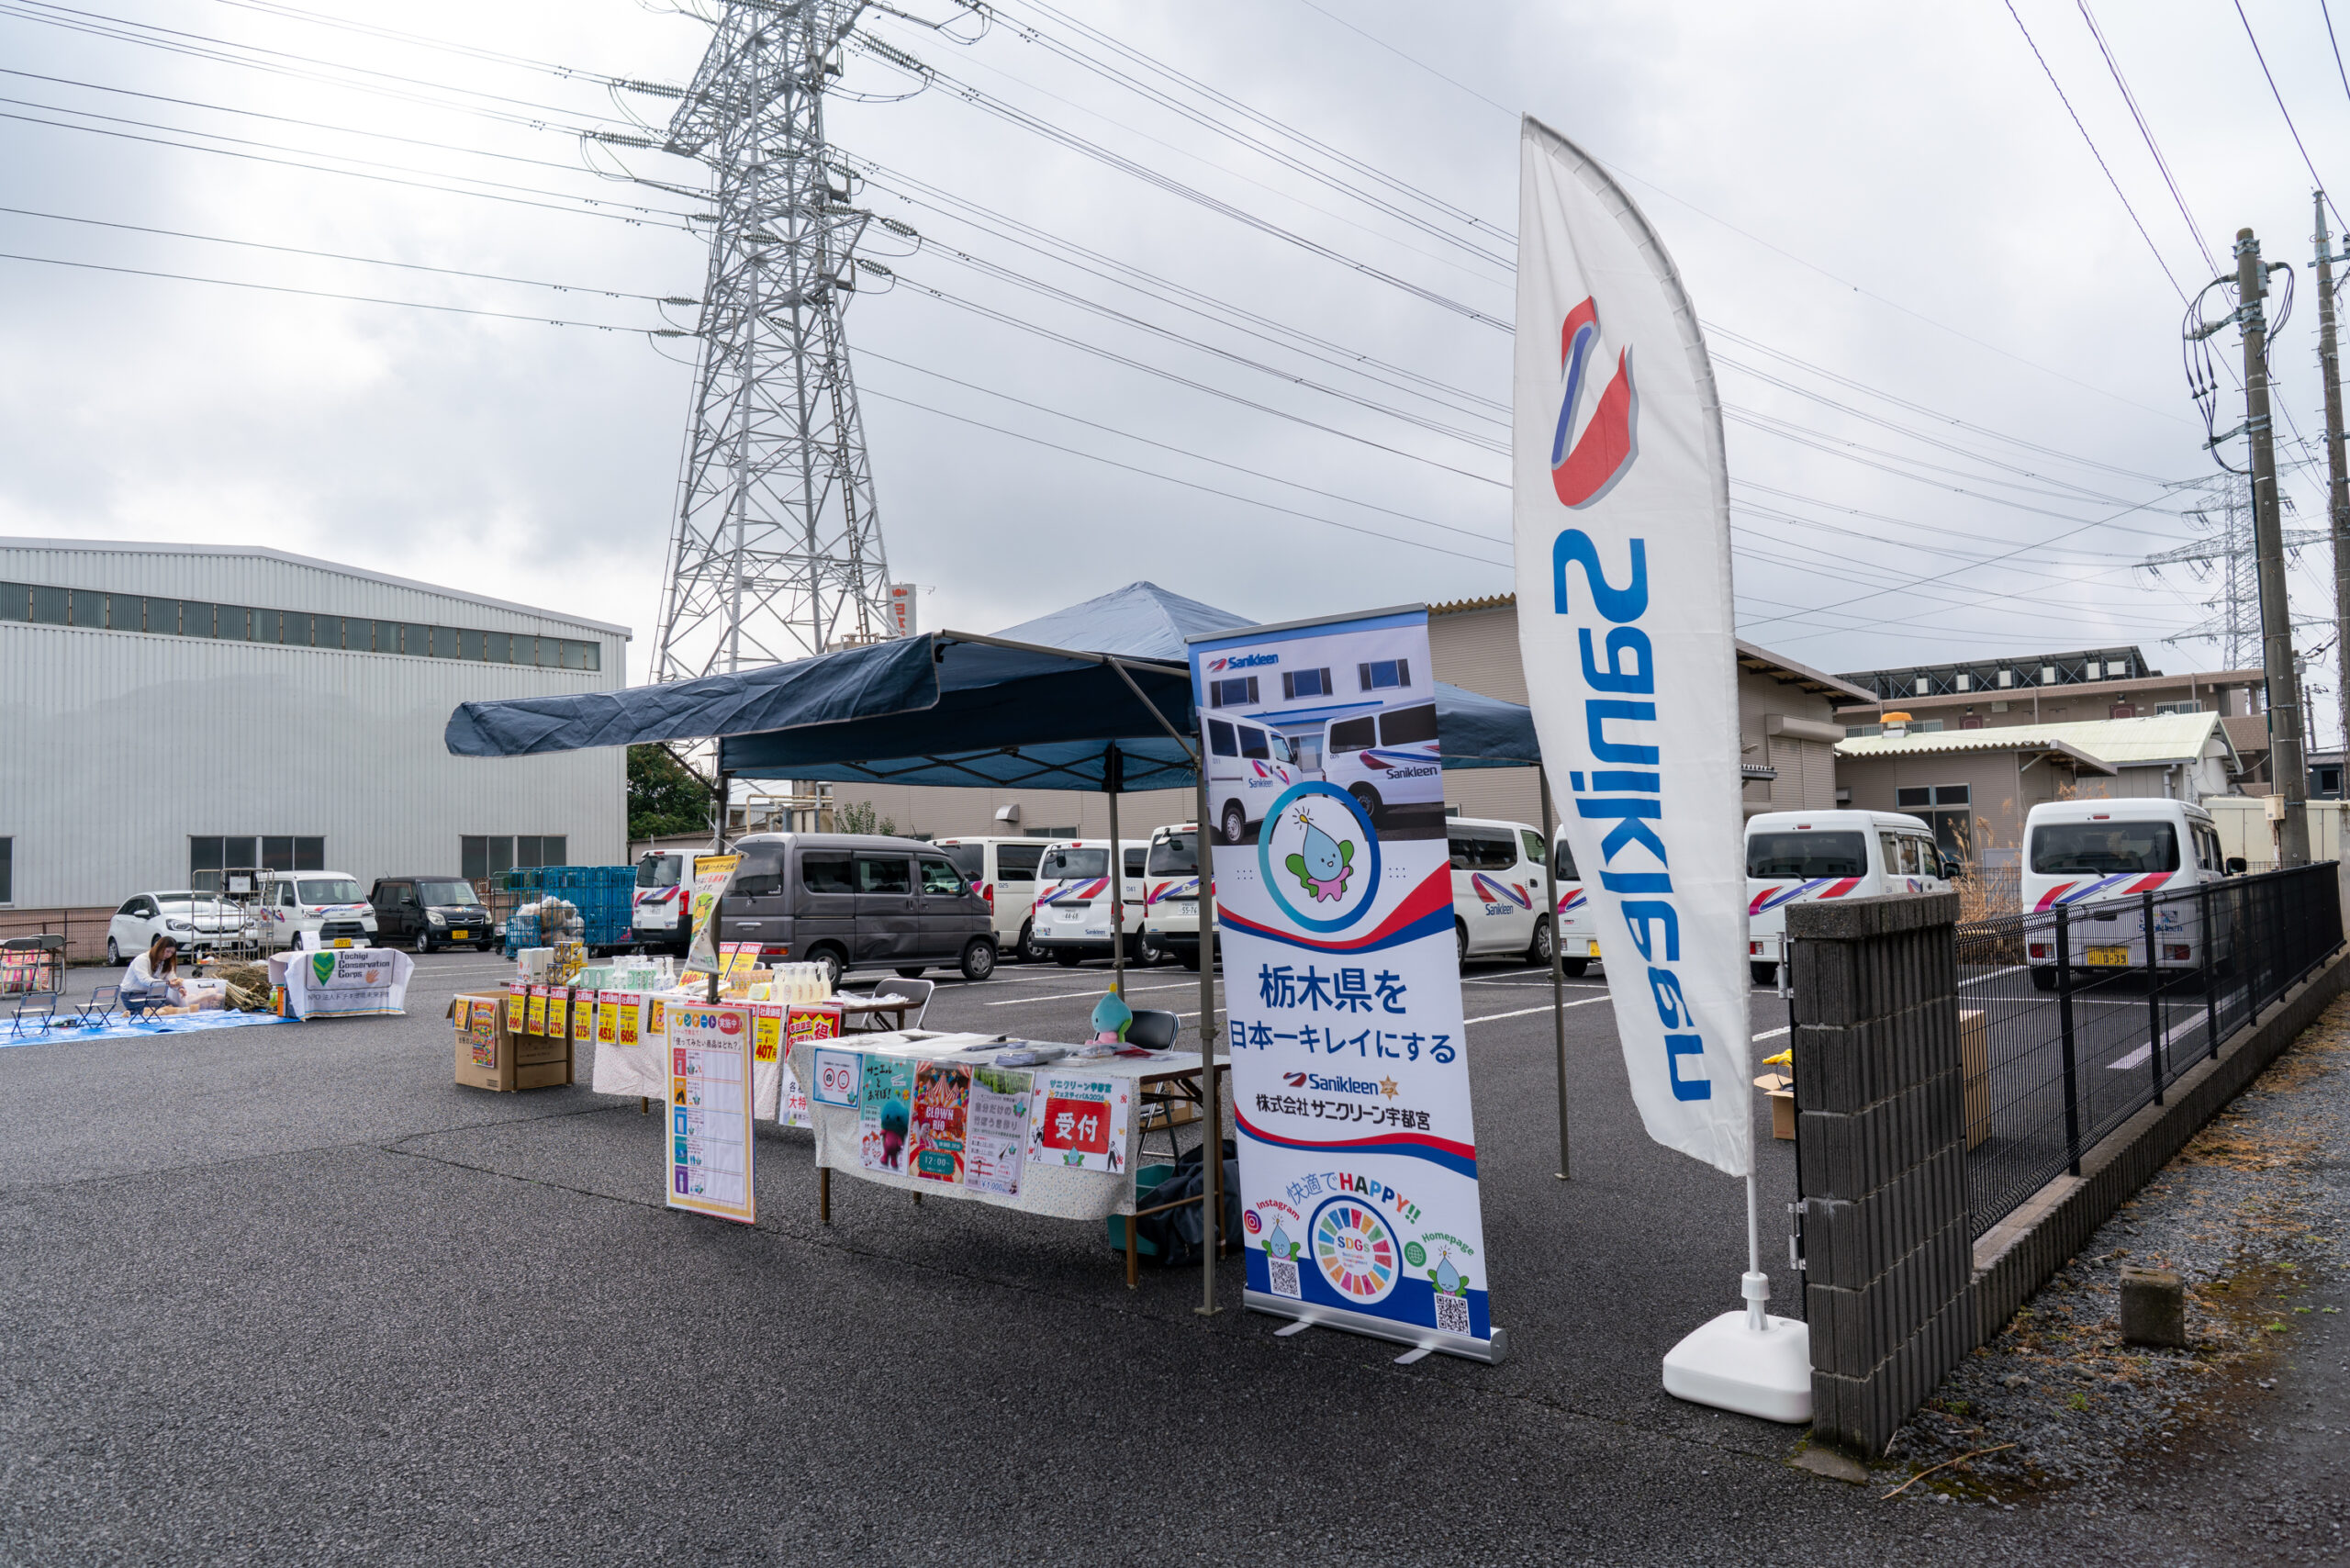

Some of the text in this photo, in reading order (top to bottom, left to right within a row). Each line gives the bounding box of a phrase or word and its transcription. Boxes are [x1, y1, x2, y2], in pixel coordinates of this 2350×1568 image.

[1227, 653, 1279, 669] Sanikleen
[1386, 765, 1438, 779] Sanikleen
[1248, 778, 1274, 789] Sanikleen
[1485, 903, 1514, 916] Sanikleen
[338, 951, 368, 960] Tochigi
[338, 960, 390, 969] Conservation
[338, 969, 363, 979] Corps
[1259, 963, 1407, 1014] 栃木県を
[677, 1014, 715, 1027] アンケート
[1230, 1019, 1456, 1064] 日本一キレイにする
[867, 1065, 893, 1077] サニエル
[1049, 1080, 1113, 1093] サニクリーン宇都宮
[1308, 1073, 1379, 1096] Sanikleen
[925, 1106, 955, 1121] CLOWN
[932, 1120, 946, 1132] RIO
[1055, 1112, 1099, 1143] 受付
[1256, 1198, 1301, 1222] Instagram
[1337, 1236, 1371, 1254] SDGs
[1421, 1232, 1476, 1257] Homepage
